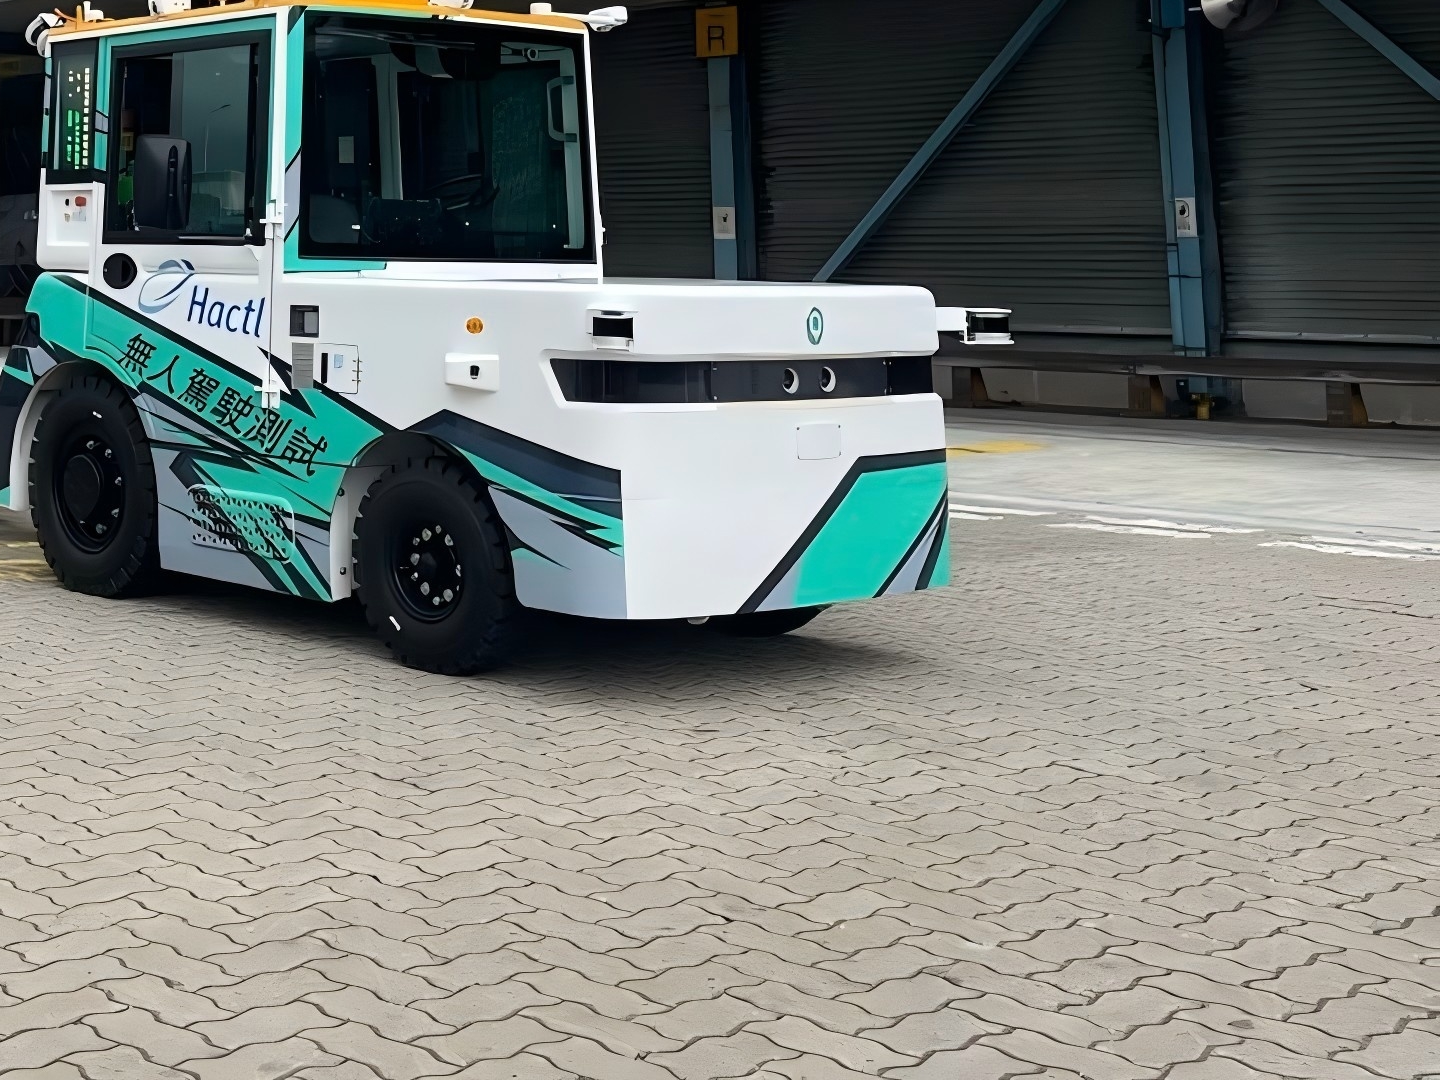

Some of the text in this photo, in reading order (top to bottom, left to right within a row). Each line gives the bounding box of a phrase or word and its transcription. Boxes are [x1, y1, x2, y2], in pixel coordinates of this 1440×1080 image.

[187, 285, 265, 338] Hactl
[117, 333, 328, 477] 無人駕駛測試
